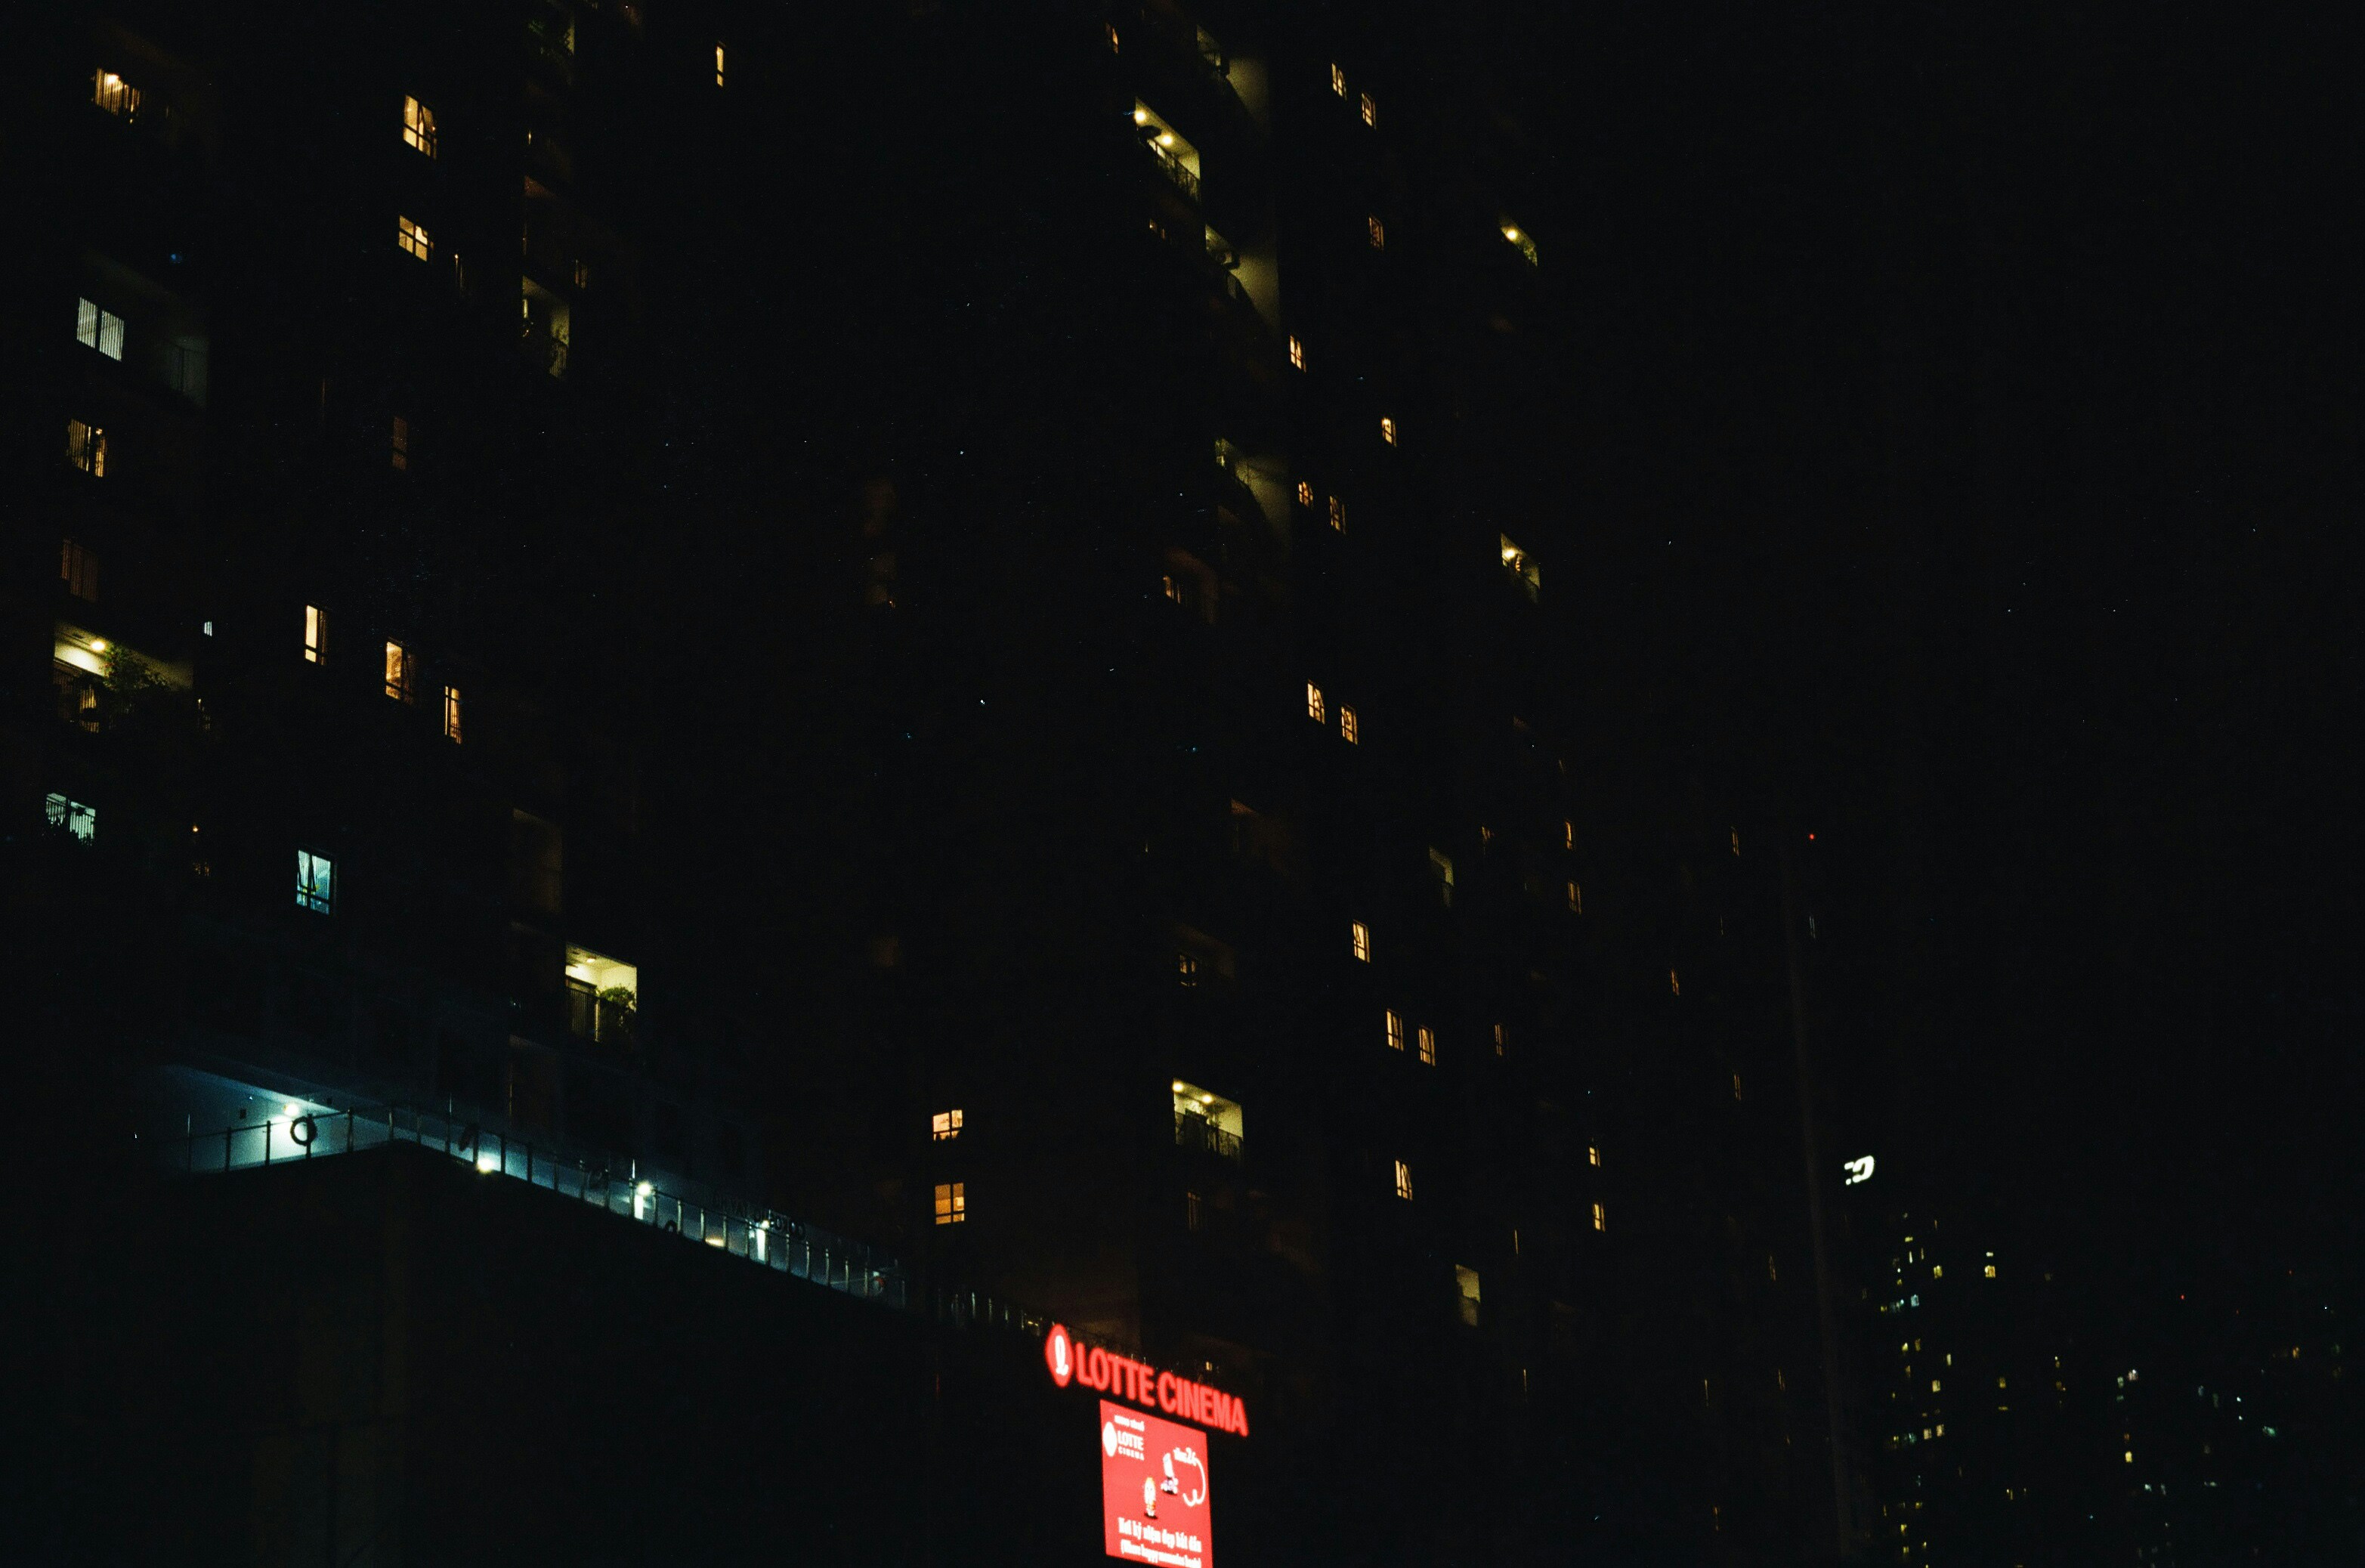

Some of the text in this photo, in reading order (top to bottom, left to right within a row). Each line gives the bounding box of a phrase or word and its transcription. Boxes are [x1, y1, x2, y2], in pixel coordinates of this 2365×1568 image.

[1075, 1342, 1156, 1406] LOTTE
[1158, 1371, 1249, 1437] CINEMA
[1117, 1430, 1144, 1451] LOTTE
